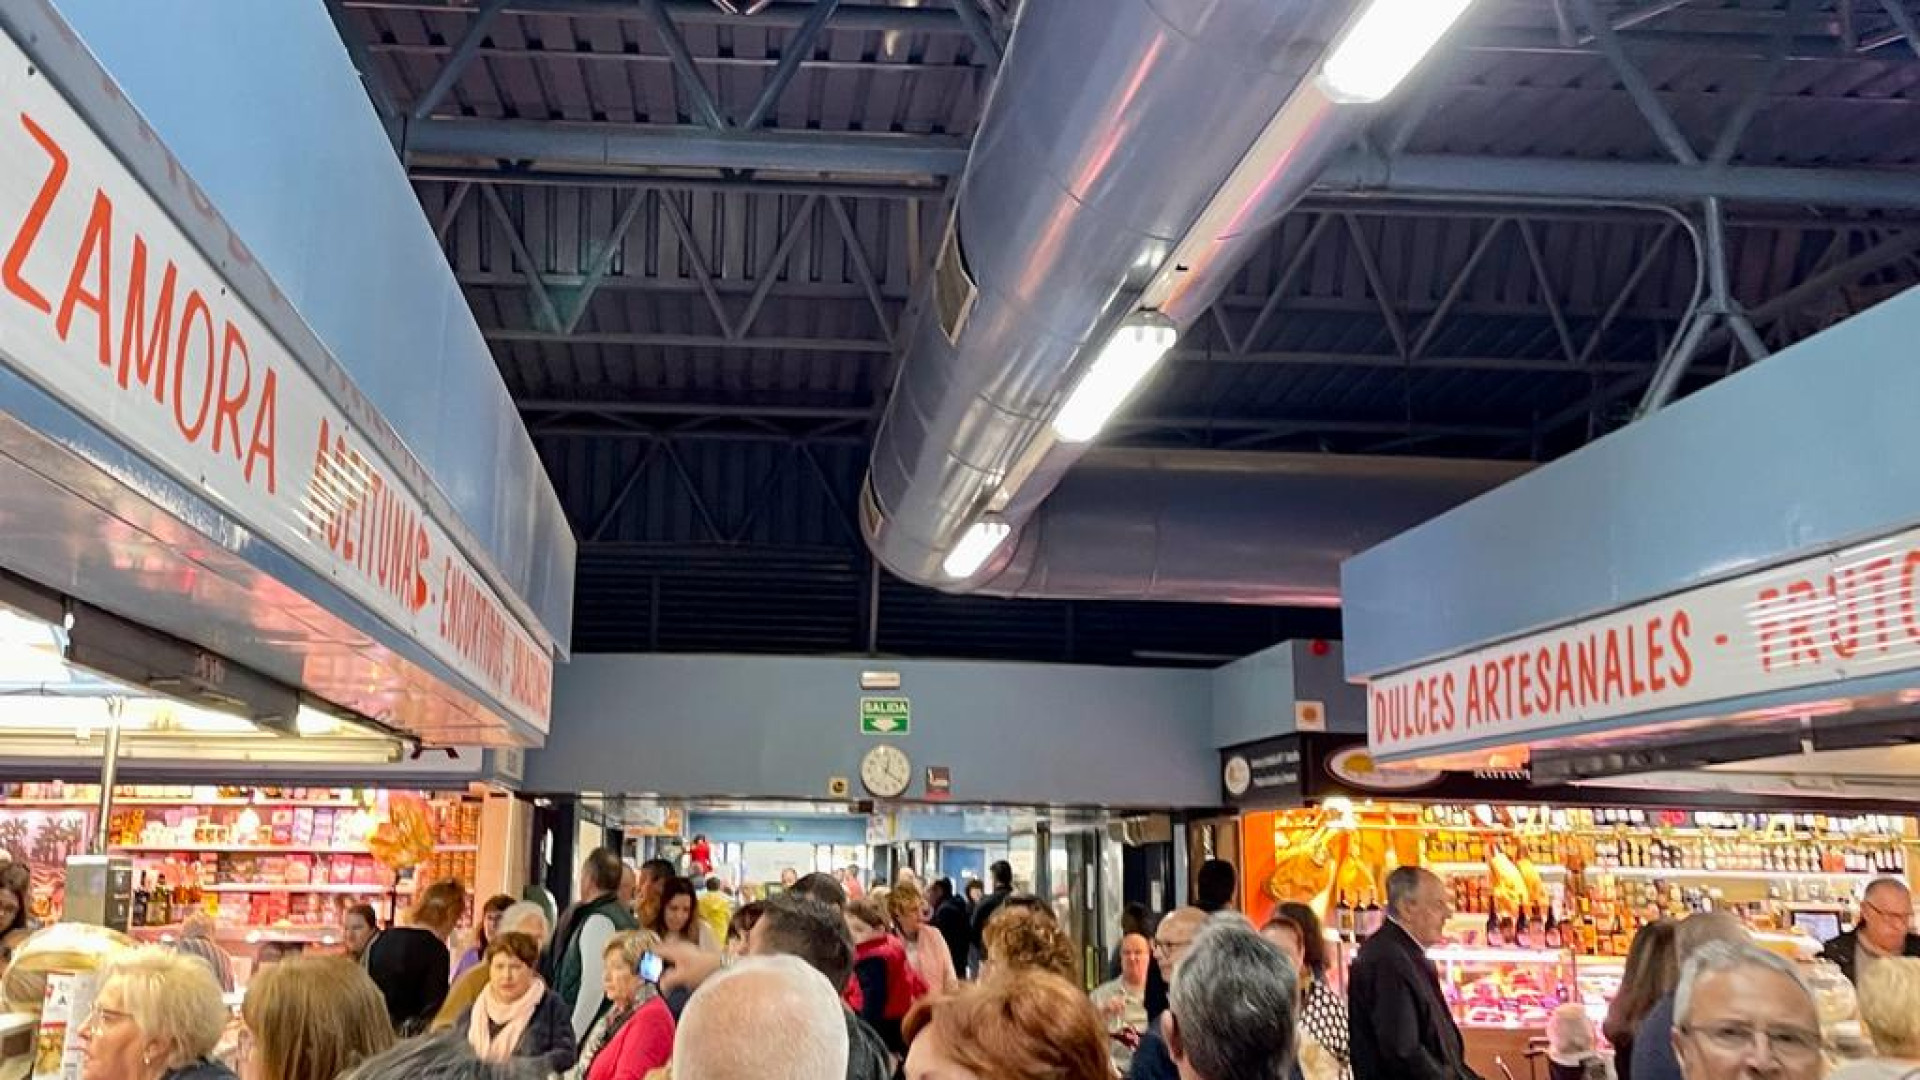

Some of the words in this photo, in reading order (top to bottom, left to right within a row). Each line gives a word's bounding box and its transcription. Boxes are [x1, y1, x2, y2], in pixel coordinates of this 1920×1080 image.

[2, 111, 277, 495] ZAMORA
[864, 701, 908, 714] SALIDA
[1375, 672, 1455, 745] DULCES
[1465, 609, 1692, 728] ARTESANALES
